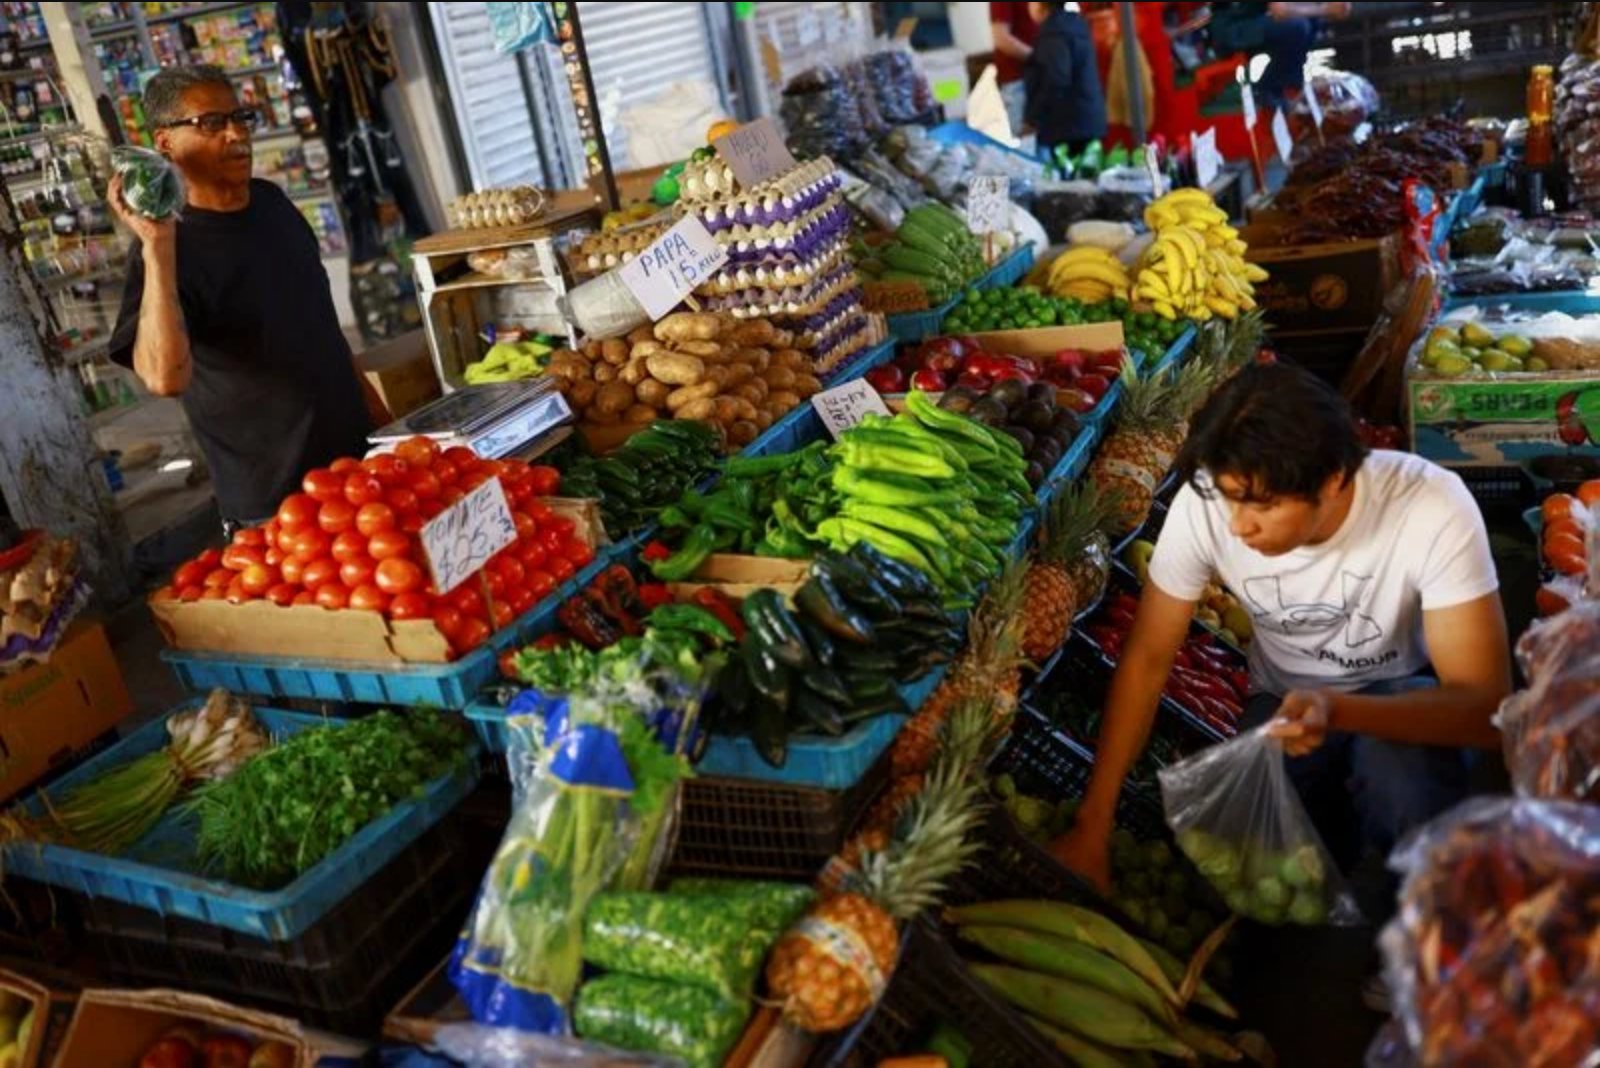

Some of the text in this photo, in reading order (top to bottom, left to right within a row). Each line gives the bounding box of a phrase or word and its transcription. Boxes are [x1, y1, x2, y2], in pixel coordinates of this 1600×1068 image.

[639, 232, 690, 277] PAPA
[669, 260, 697, 289] 15
[1470, 393, 1549, 411] PEARS
